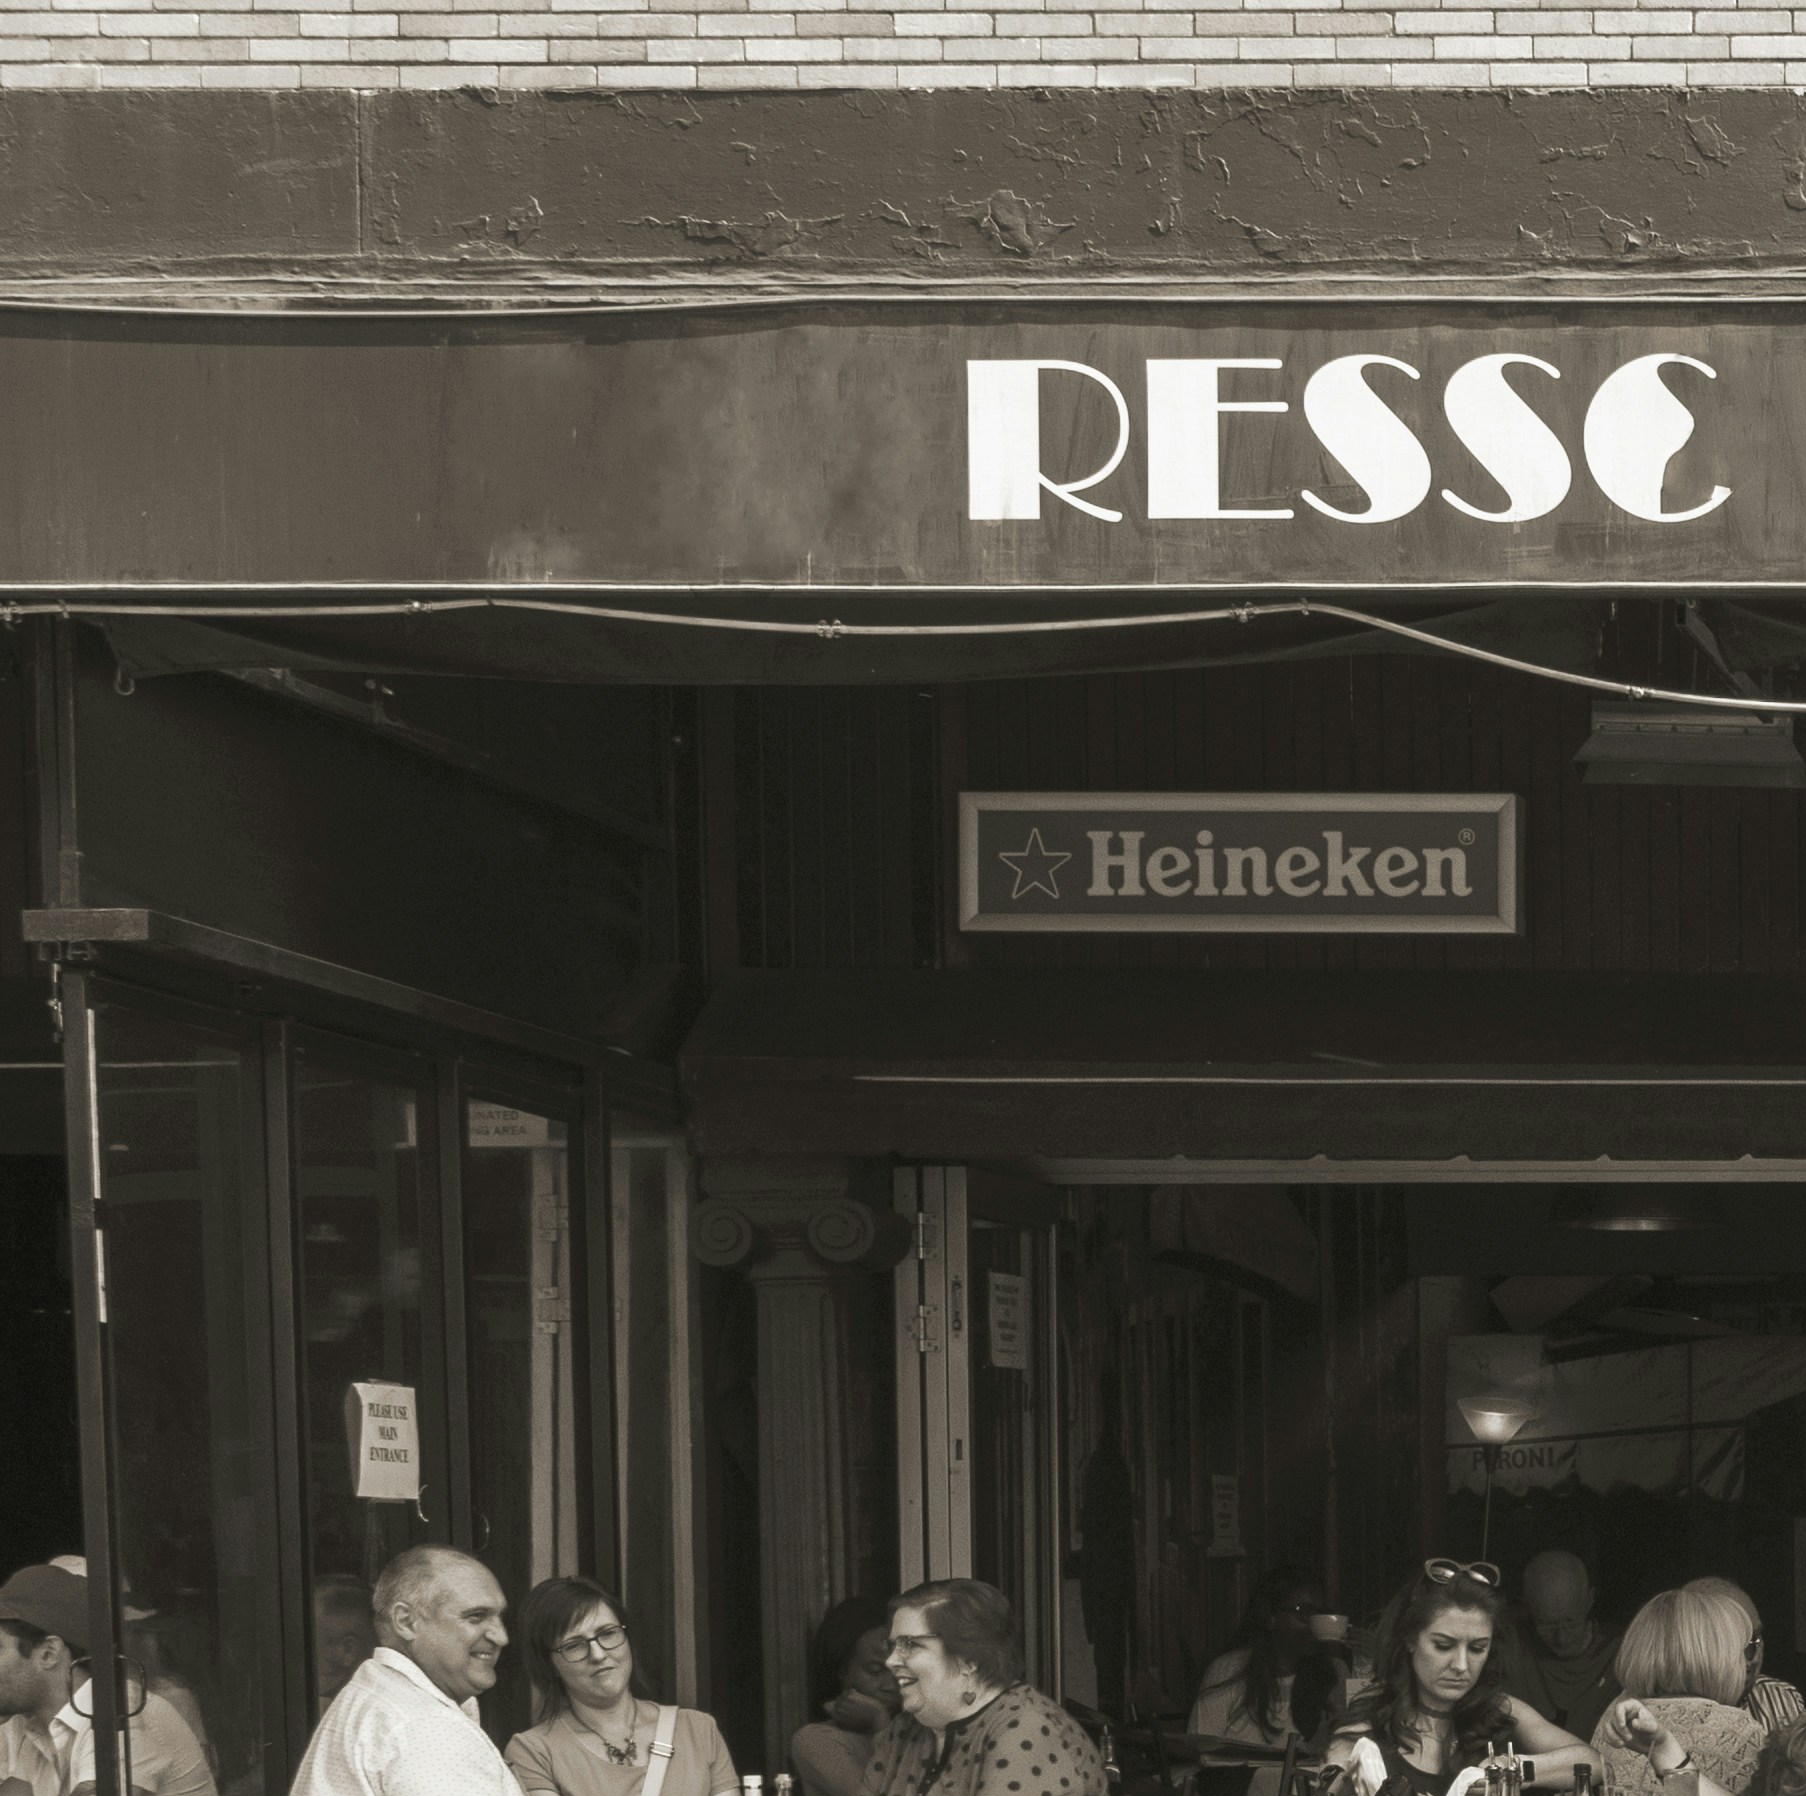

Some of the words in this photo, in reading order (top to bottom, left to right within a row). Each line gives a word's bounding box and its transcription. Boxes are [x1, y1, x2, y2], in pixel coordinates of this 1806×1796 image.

[368, 1402, 393, 1418] PLEASE
[393, 1405, 409, 1420] USE
[378, 1425, 399, 1440] MAIN
[369, 1446, 409, 1463] ENTRANCE
[1472, 1446, 1555, 1472] PRONI
